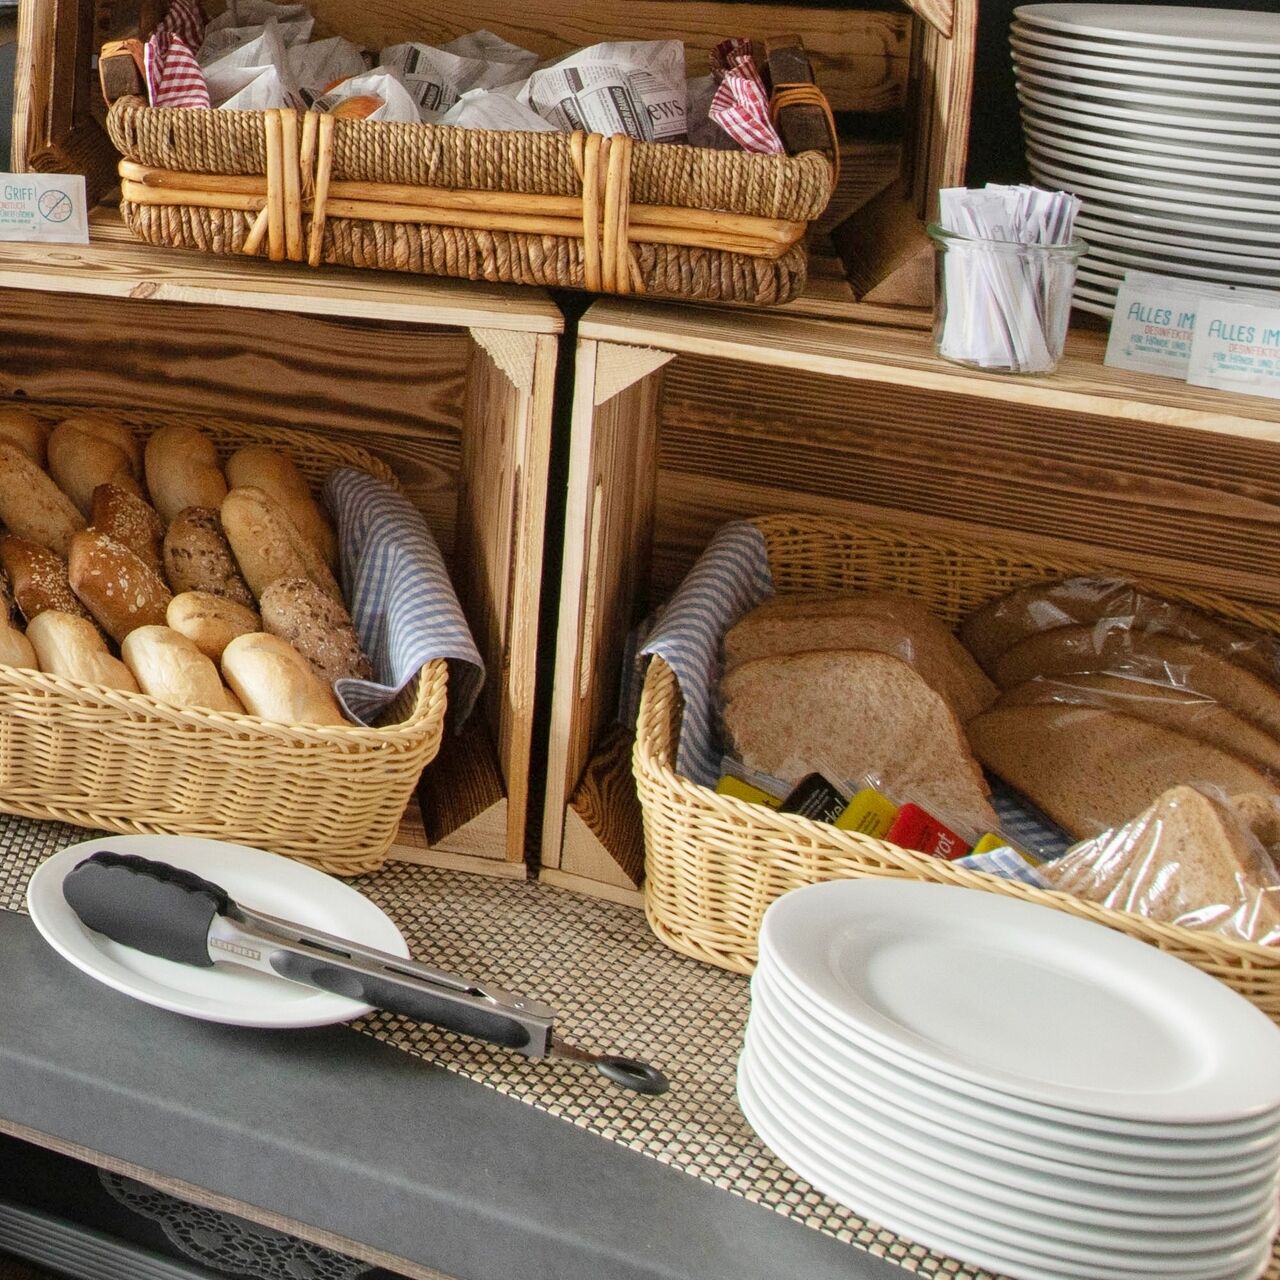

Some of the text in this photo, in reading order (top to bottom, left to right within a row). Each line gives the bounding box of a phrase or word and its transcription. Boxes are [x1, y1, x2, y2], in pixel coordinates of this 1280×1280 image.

[646, 98, 685, 121] ews
[5, 185, 37, 200] GRIFF!
[1127, 302, 1195, 330] ALLES IM
[1208, 320, 1280, 347] ALLES IM
